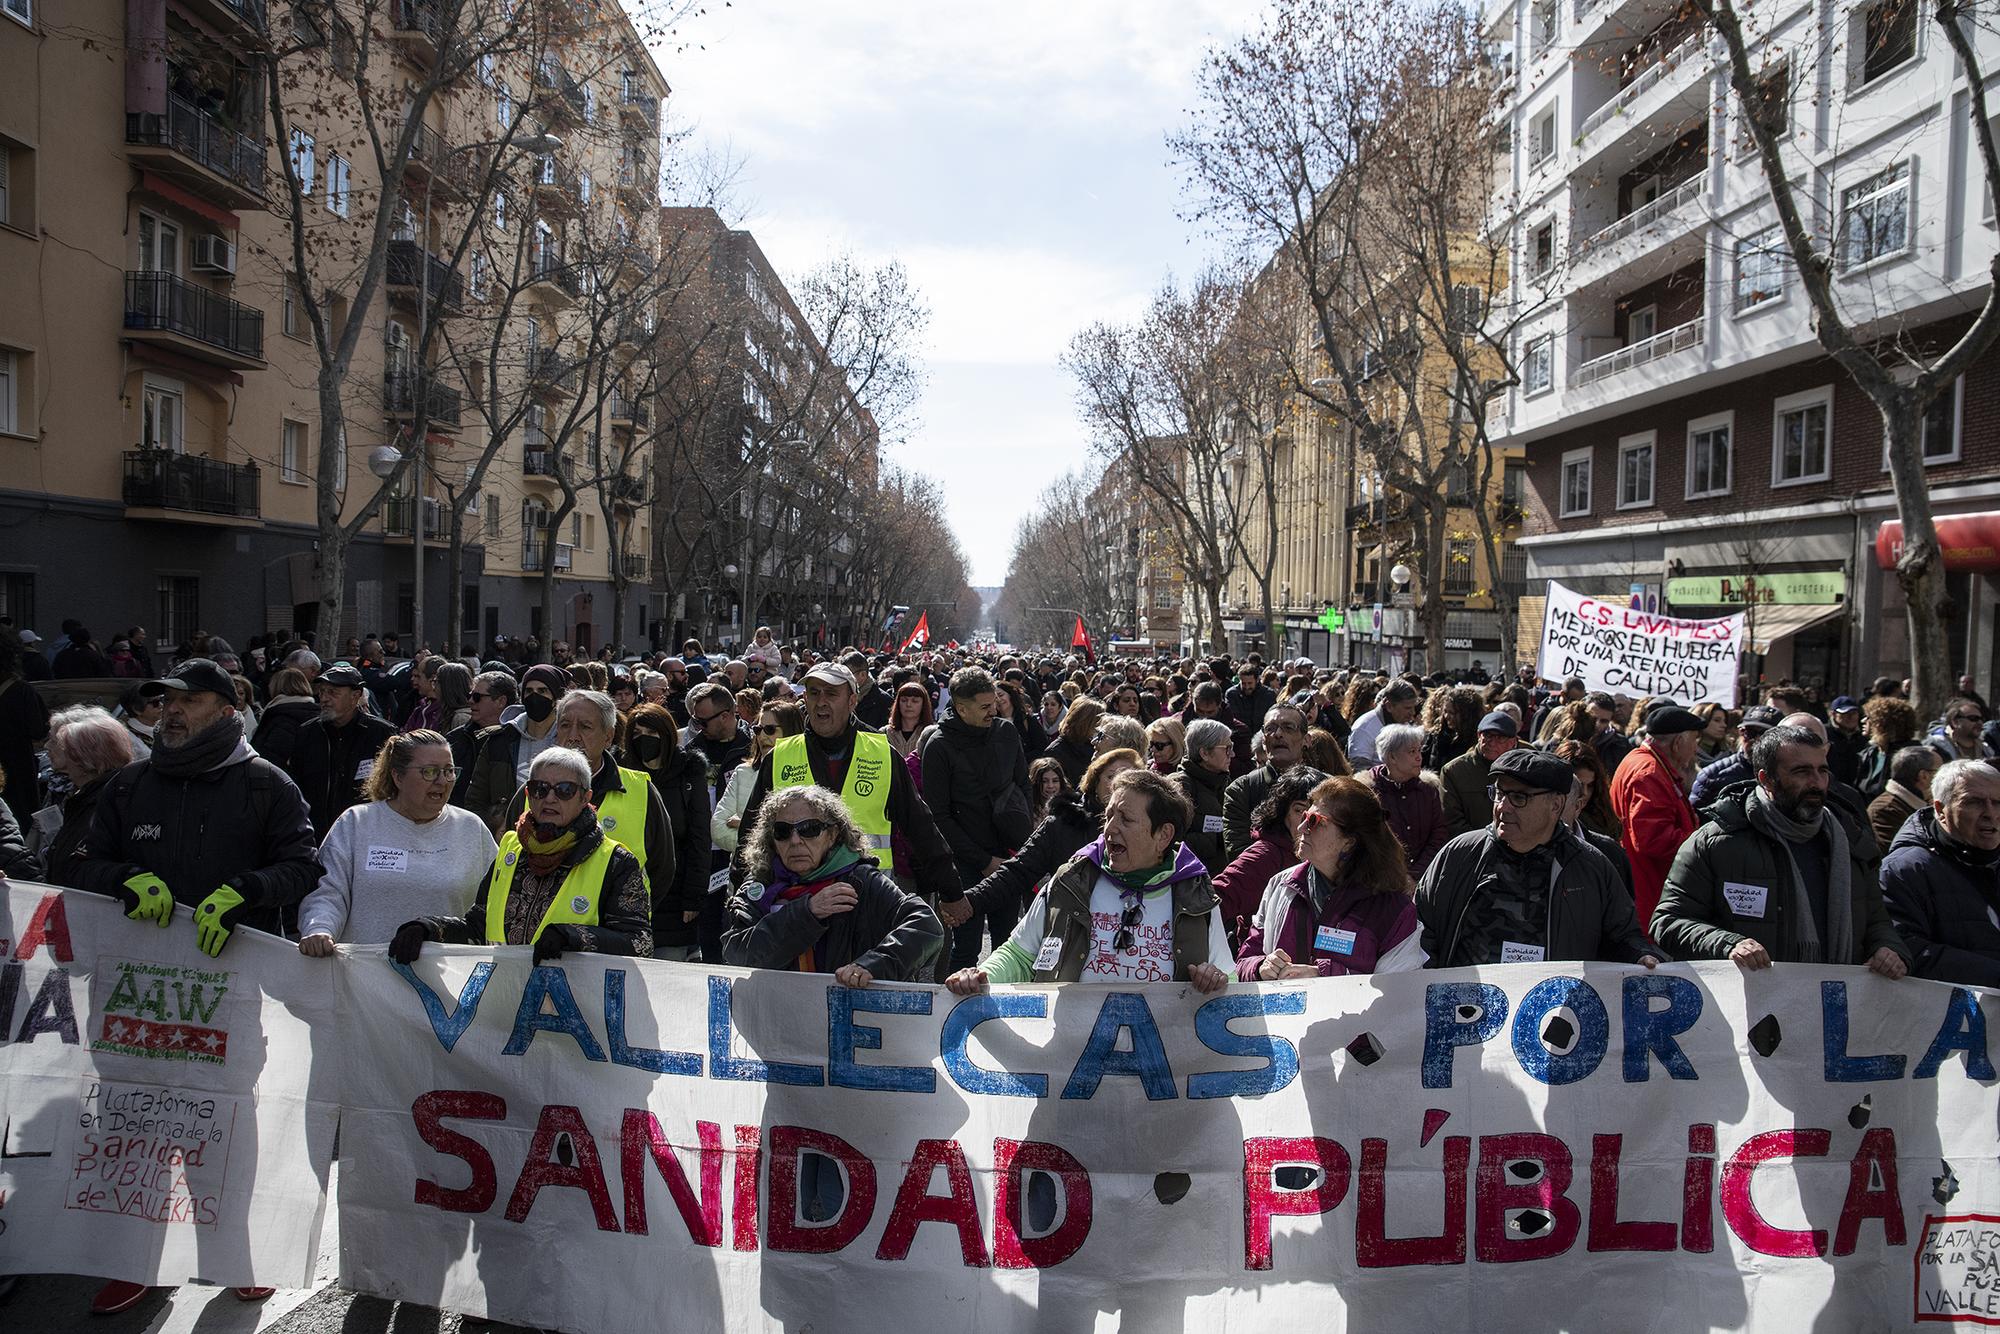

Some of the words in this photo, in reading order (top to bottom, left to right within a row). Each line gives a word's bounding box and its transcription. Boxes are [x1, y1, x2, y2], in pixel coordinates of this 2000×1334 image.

[1578, 601, 1615, 626] C.S.
[1549, 629, 1579, 654] POR
[1584, 643, 1614, 664] UNA
[1629, 633, 1656, 656] EN
[1663, 636, 1737, 662] HUELGA
[1562, 656, 1588, 679] DE
[859, 783, 870, 793] VK
[1083, 961, 1120, 976] ARA
[390, 960, 1307, 1101] VALLECAS
[1421, 975, 1704, 1089] POR
[1820, 980, 1998, 1082] LA
[86, 1083, 215, 1119] Plataforma
[80, 1112, 102, 1129] en
[109, 1112, 185, 1138] Defensa
[186, 1120, 205, 1141] de
[208, 1121, 223, 1144] la
[78, 1133, 207, 1168] Sanidad
[77, 1183, 106, 1209] de
[113, 1187, 218, 1225] VALLEKAS
[1921, 1252, 1943, 1266] POR
[1950, 1252, 1966, 1264] LA
[1925, 1288, 2000, 1315] VALLE
